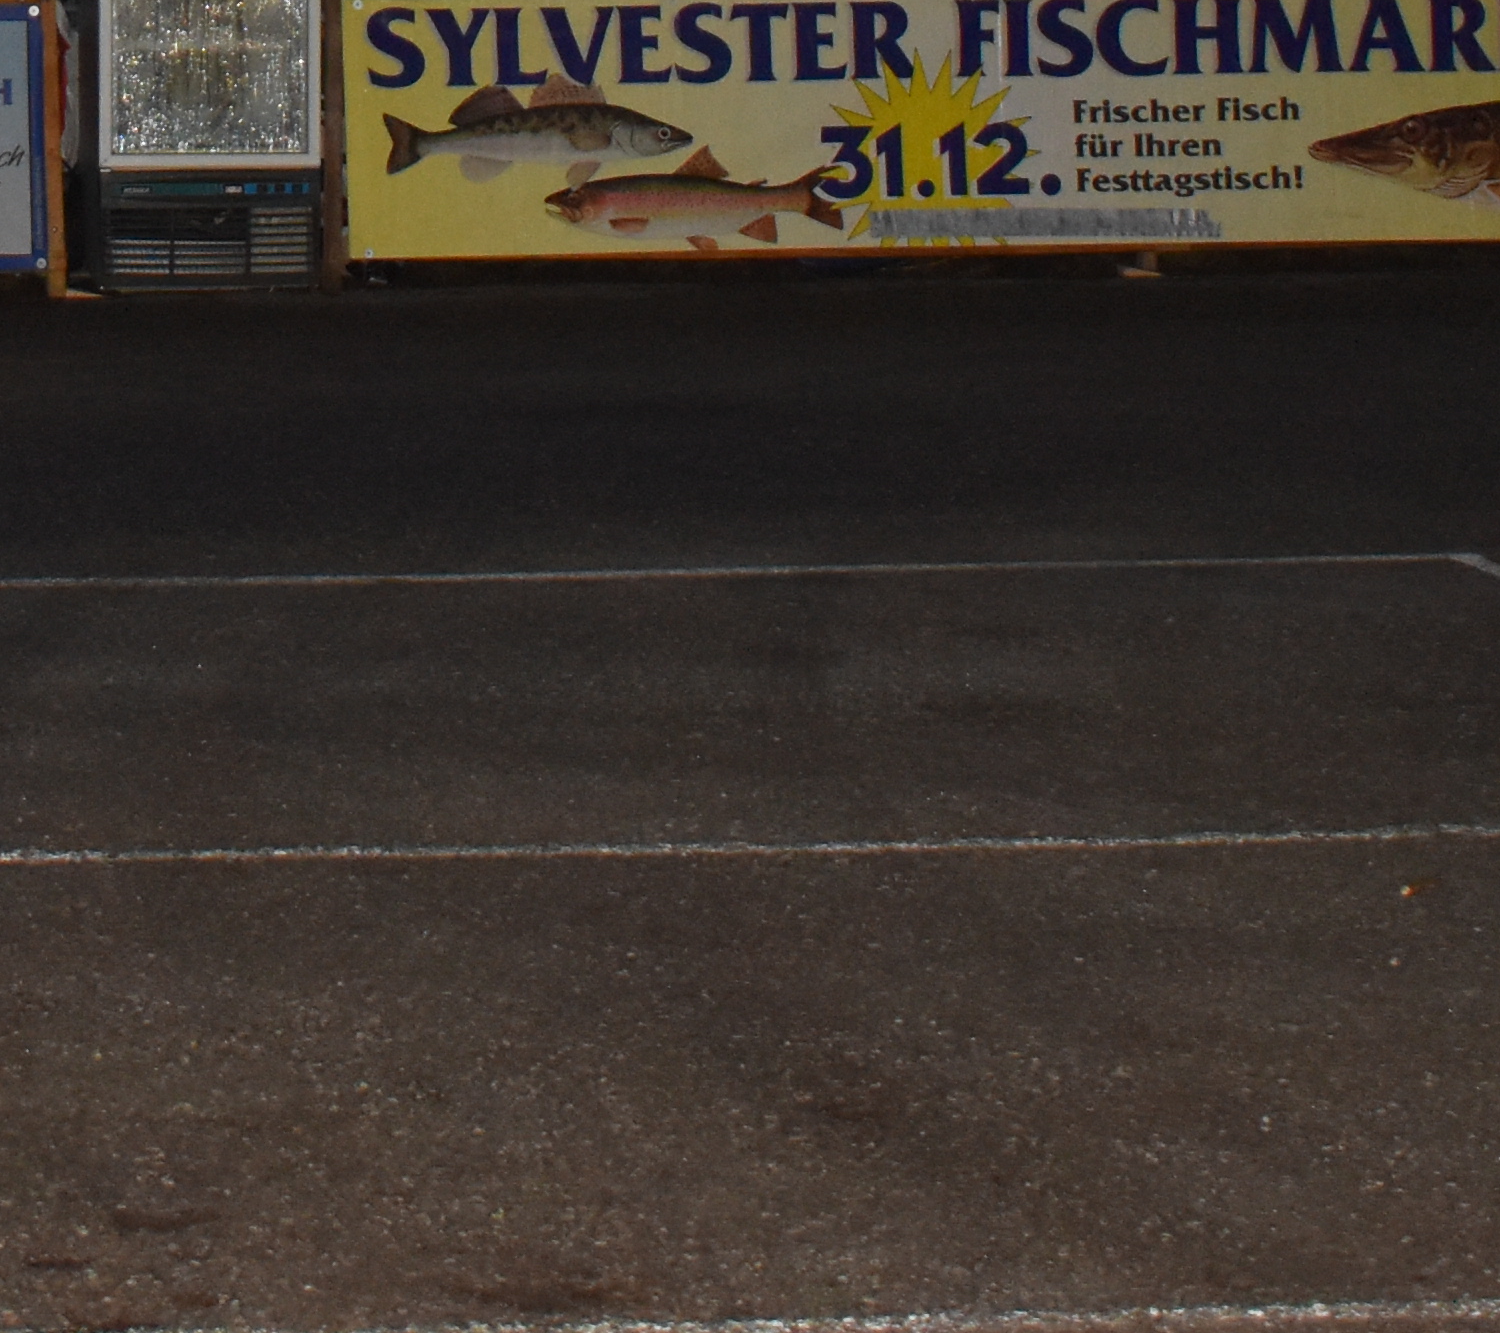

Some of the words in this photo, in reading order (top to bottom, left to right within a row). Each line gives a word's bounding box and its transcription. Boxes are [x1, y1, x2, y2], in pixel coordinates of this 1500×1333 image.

[366, 0, 914, 88] SYLVESTER
[1073, 97, 1206, 124] Frischer
[1216, 95, 1301, 122] Fisch
[1074, 132, 1123, 159] für
[1134, 130, 1222, 158] Ihren
[1075, 165, 1304, 199] Festtagstisch!
